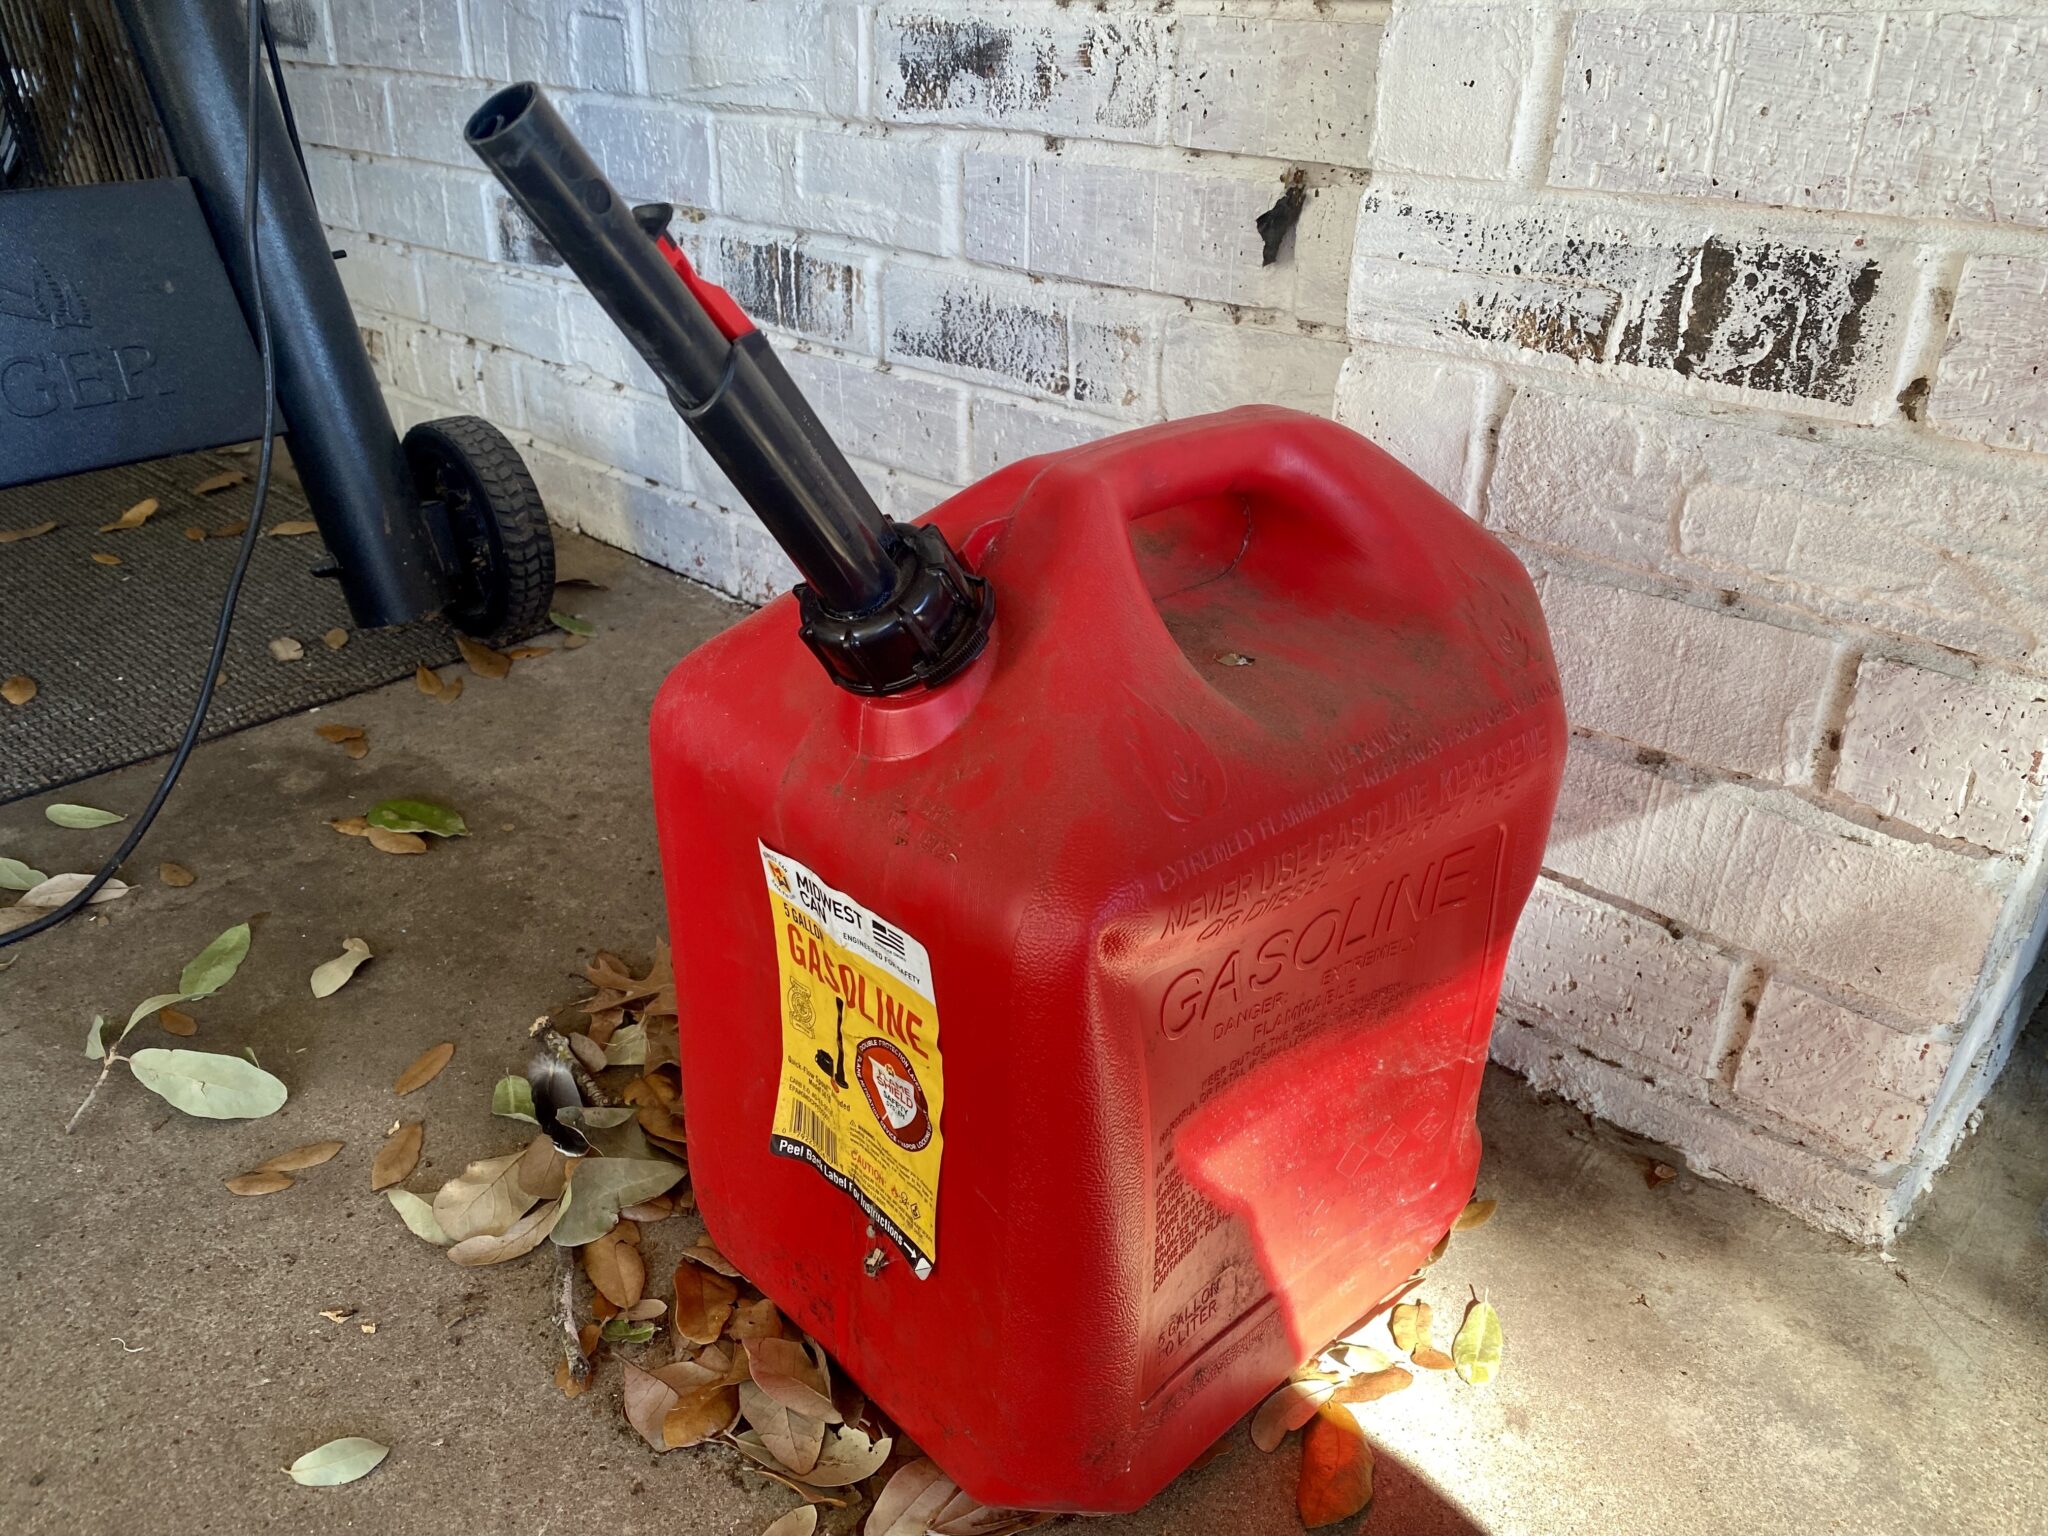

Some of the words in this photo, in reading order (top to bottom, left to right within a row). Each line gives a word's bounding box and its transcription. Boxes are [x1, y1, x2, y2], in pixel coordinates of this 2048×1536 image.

[1161, 874, 1253, 940] NEVER
[1260, 843, 1311, 894] USE
[1438, 724, 1551, 804] KEROSENE
[1157, 826, 1255, 893] EXTREMELY
[783, 902, 792, 918] 5
[791, 908, 824, 942] GALLON
[796, 871, 862, 929] MIDWEST
[799, 890, 827, 924] CAN
[1197, 909, 1244, 942] OR
[1241, 866, 1330, 926] DIESEL
[842, 932, 883, 961] ENGINEERED
[896, 966, 921, 985] SAFETY
[1160, 846, 1477, 1041] GASOLINE
[1322, 934, 1419, 986] EXTREMELY
[786, 923, 929, 1060] GASOLINE
[1252, 977, 1357, 1042] FLAMMABLE
[859, 1039, 878, 1052] DOUBLE
[879, 1039, 909, 1068] PROTECTION
[1229, 1051, 1250, 1072] OUT
[1252, 1042, 1266, 1057] OF
[876, 1075, 913, 1109] SHIELD
[877, 1068, 910, 1097] FLAME
[883, 1090, 909, 1115] SAFETY
[1214, 1068, 1245, 1094] FATAL
[780, 1139, 804, 1156] Peel
[806, 1149, 823, 1171] Back
[823, 1166, 847, 1190] Label
[848, 1182, 860, 1199] For
[860, 1193, 903, 1246] Instructions
[850, 1149, 887, 1187] CAUTION:
[1179, 1195, 1206, 1230] LIGHTS
[1182, 1211, 1216, 1248] SOURCE
[1153, 1233, 1200, 1294] CONTAINER
[1168, 1277, 1222, 1338] GALLON
[1178, 1300, 1218, 1346] LITER
